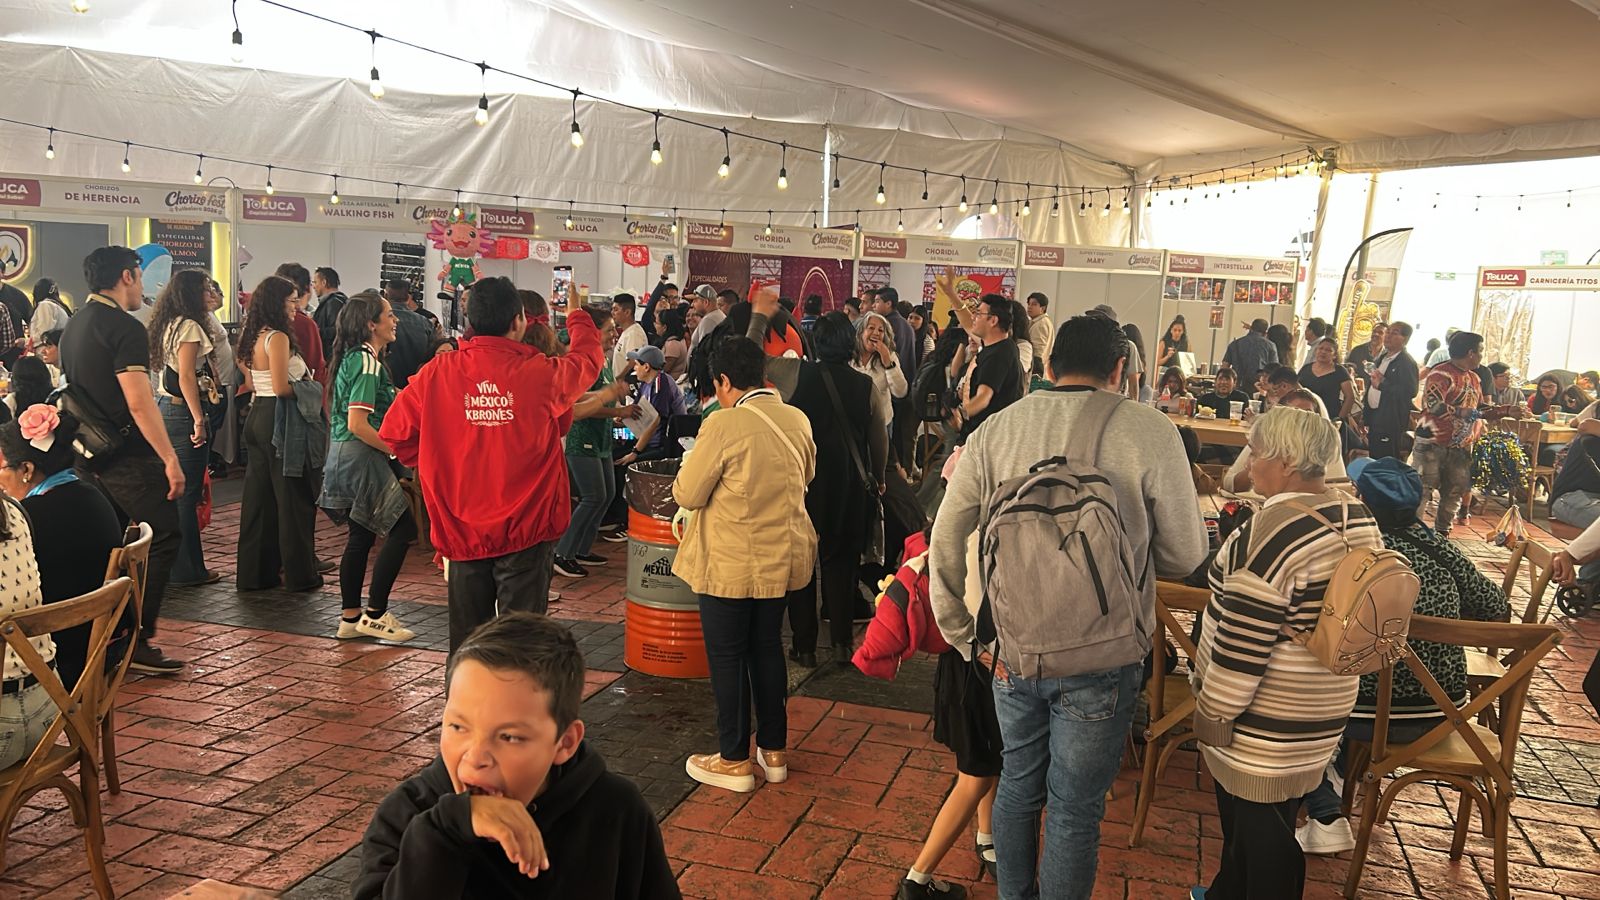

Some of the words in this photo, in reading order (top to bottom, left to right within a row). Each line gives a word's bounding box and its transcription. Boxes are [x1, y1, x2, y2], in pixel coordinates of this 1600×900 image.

[64, 192, 79, 201] DE
[82, 193, 140, 204] HERENCIA
[165, 191, 206, 206] Chorizo
[244, 198, 296, 211] TOLUCA
[323, 208, 371, 218] WALKING
[373, 210, 395, 219] FISH
[412, 205, 449, 220] Chorizo
[481, 212, 526, 225] TOLUCA
[563, 223, 599, 233] TOLUCA
[627, 221, 657, 235] Chorizo
[158, 240, 192, 248] CHORIZO
[754, 234, 791, 243] CHORIDIA
[865, 238, 900, 250] TOLUCA
[925, 247, 959, 256] CHORIDIA
[1027, 248, 1058, 260] TOLUCA
[1171, 255, 1199, 265] TOLUCA
[1485, 272, 1519, 281] TOLUCA
[1530, 277, 1575, 285] CARNICERÍA
[470, 395, 508, 408] MÉXICO
[643, 563, 677, 577] MEXLU
